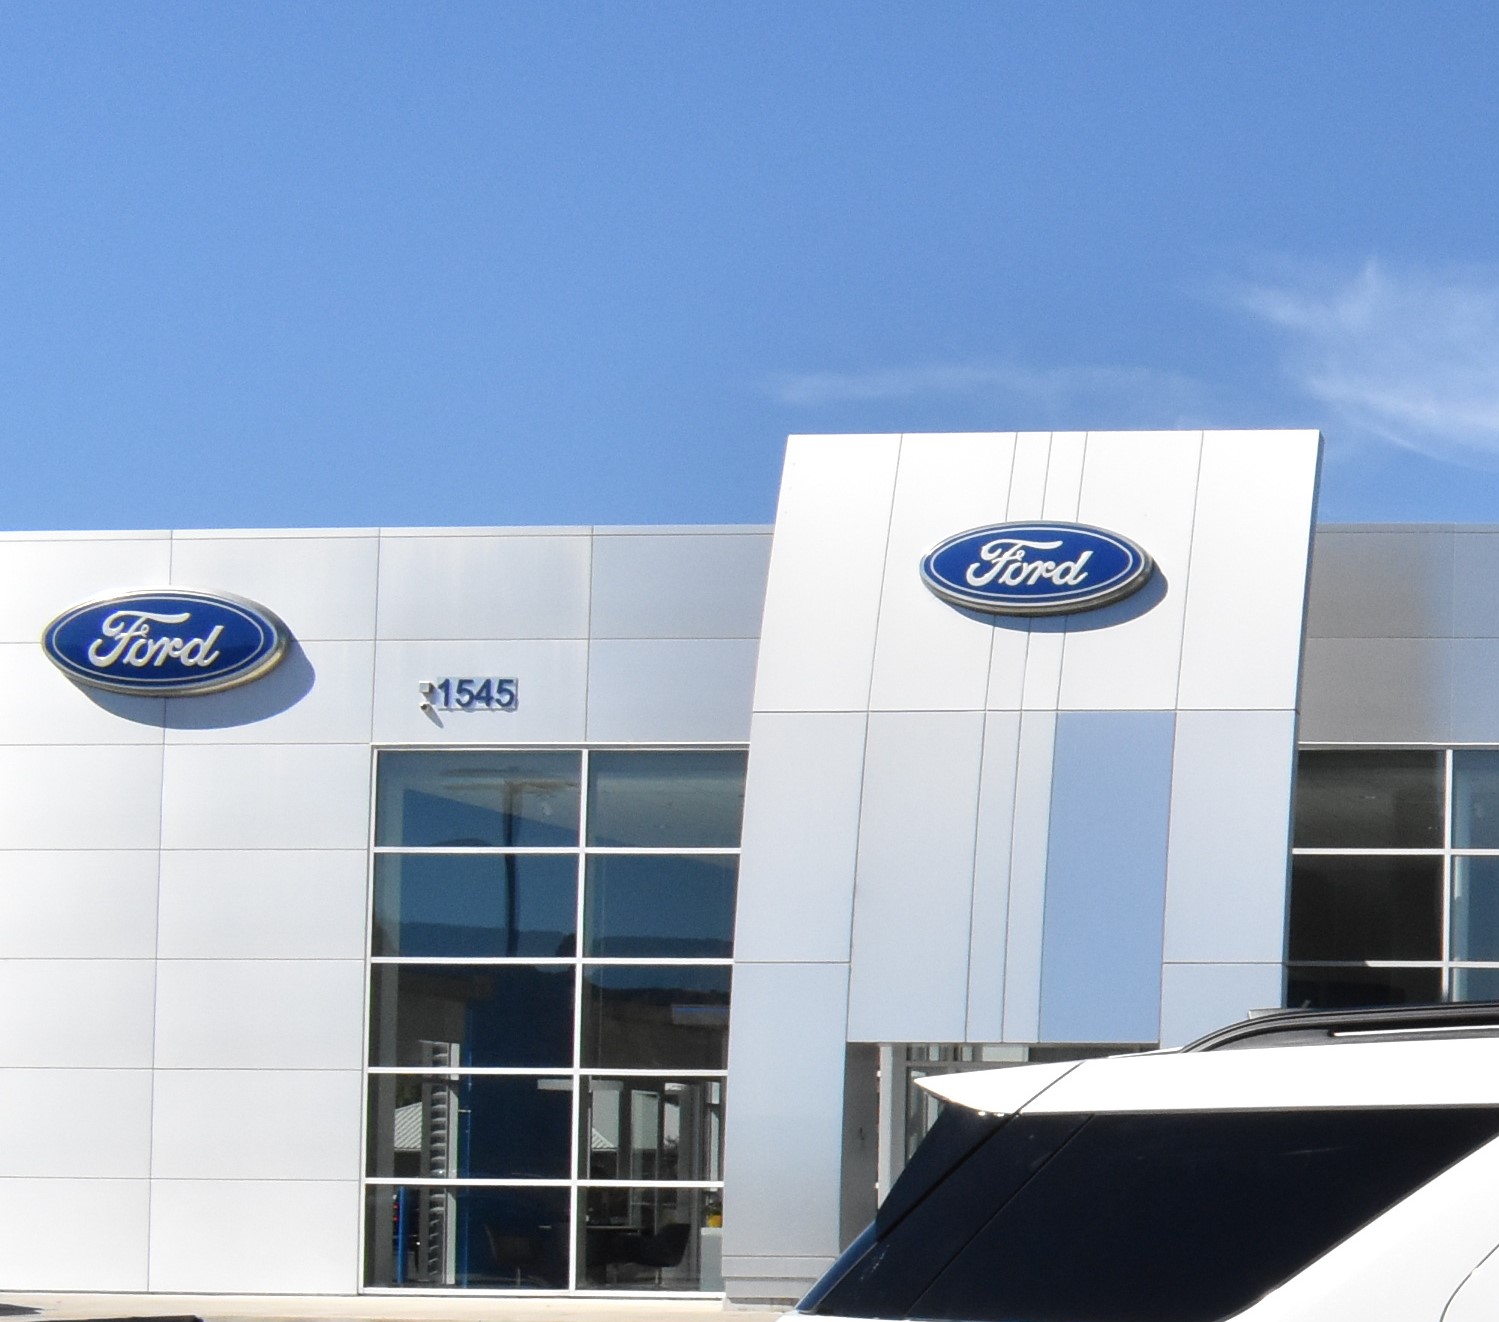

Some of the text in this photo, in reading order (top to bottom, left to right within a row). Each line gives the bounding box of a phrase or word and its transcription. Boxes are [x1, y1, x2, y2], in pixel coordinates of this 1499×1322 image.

[966, 538, 1094, 587] Ford
[88, 610, 224, 668] Ford
[437, 678, 515, 707] 1545
